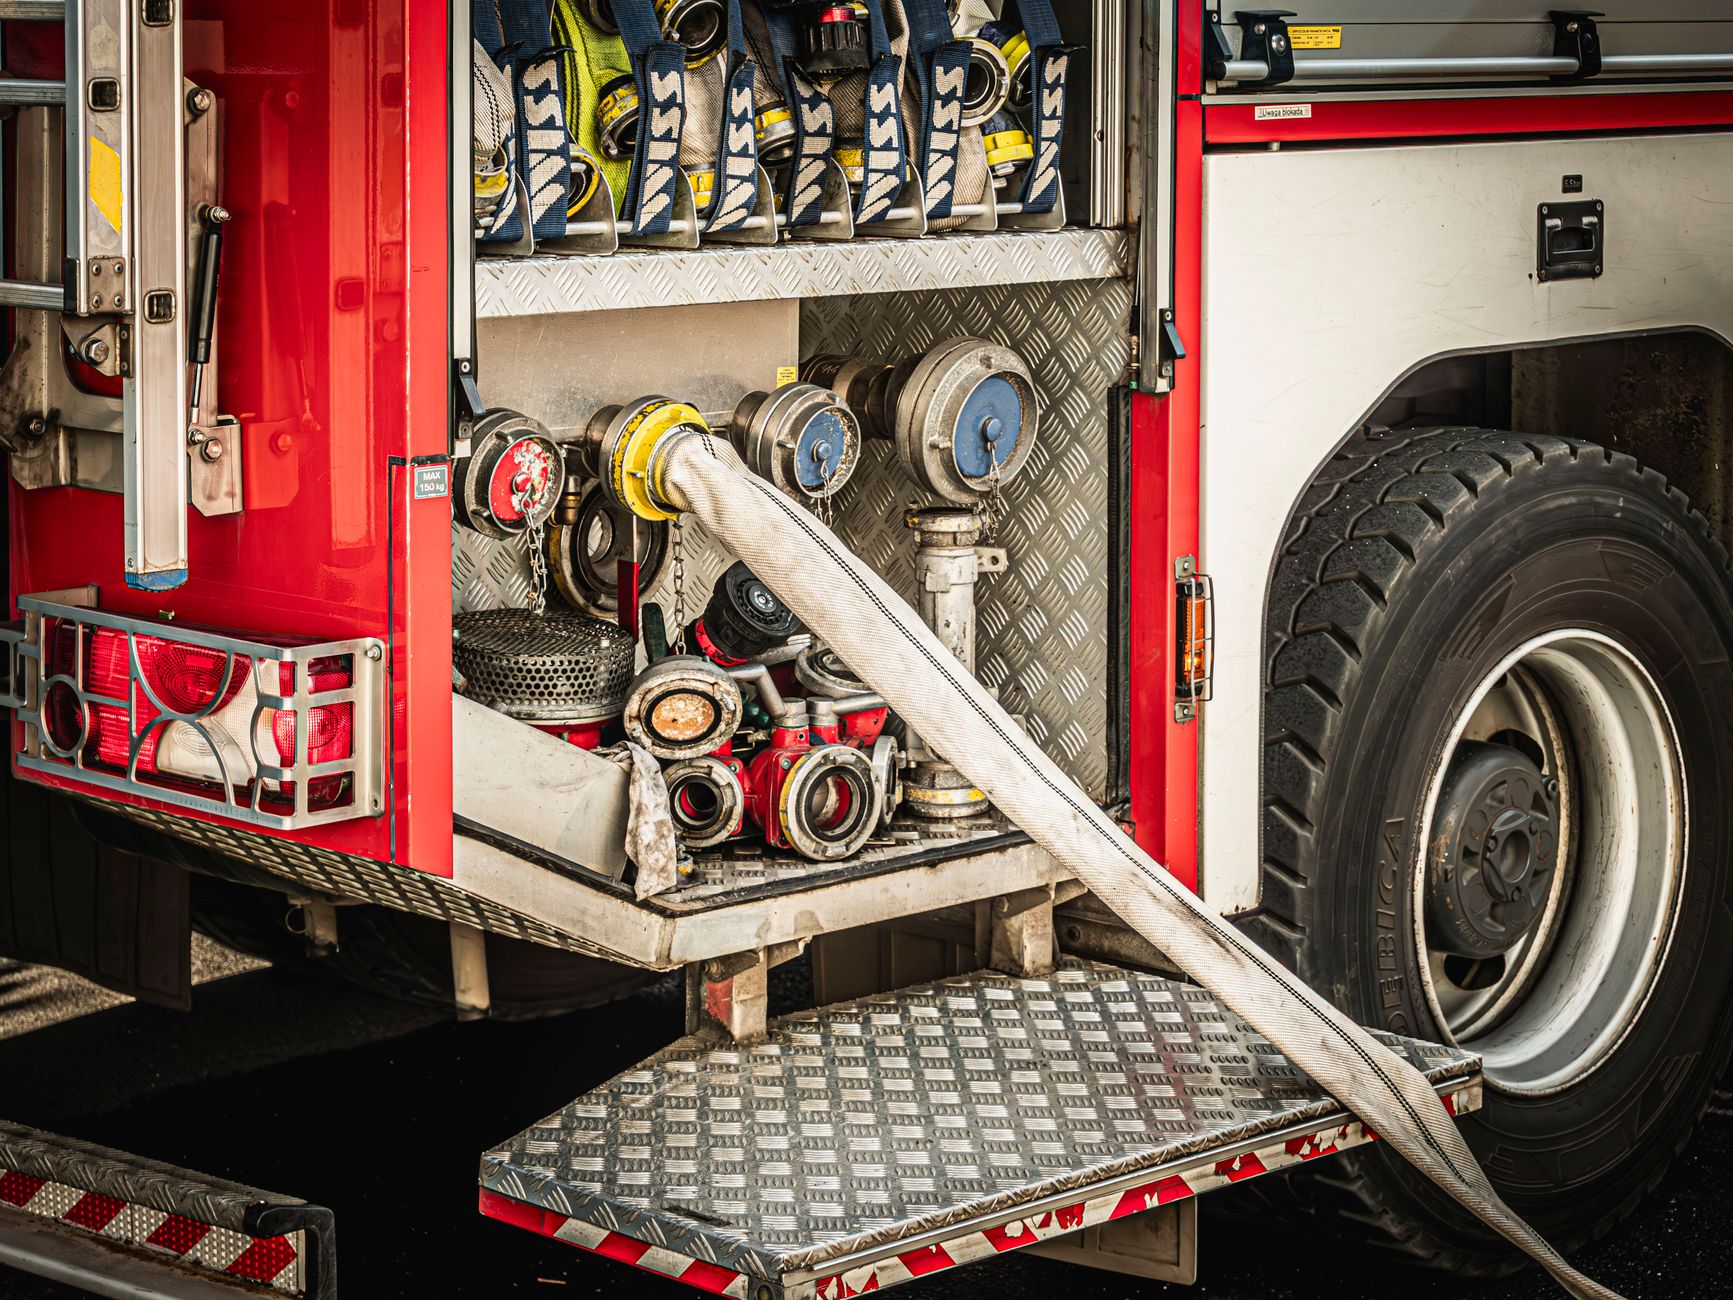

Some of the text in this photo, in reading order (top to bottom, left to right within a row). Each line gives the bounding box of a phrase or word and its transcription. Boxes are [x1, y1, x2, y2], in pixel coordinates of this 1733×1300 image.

[1282, 108, 1303, 116] blokada
[423, 471, 441, 481] MAX
[419, 482, 445, 492] 150 kg
